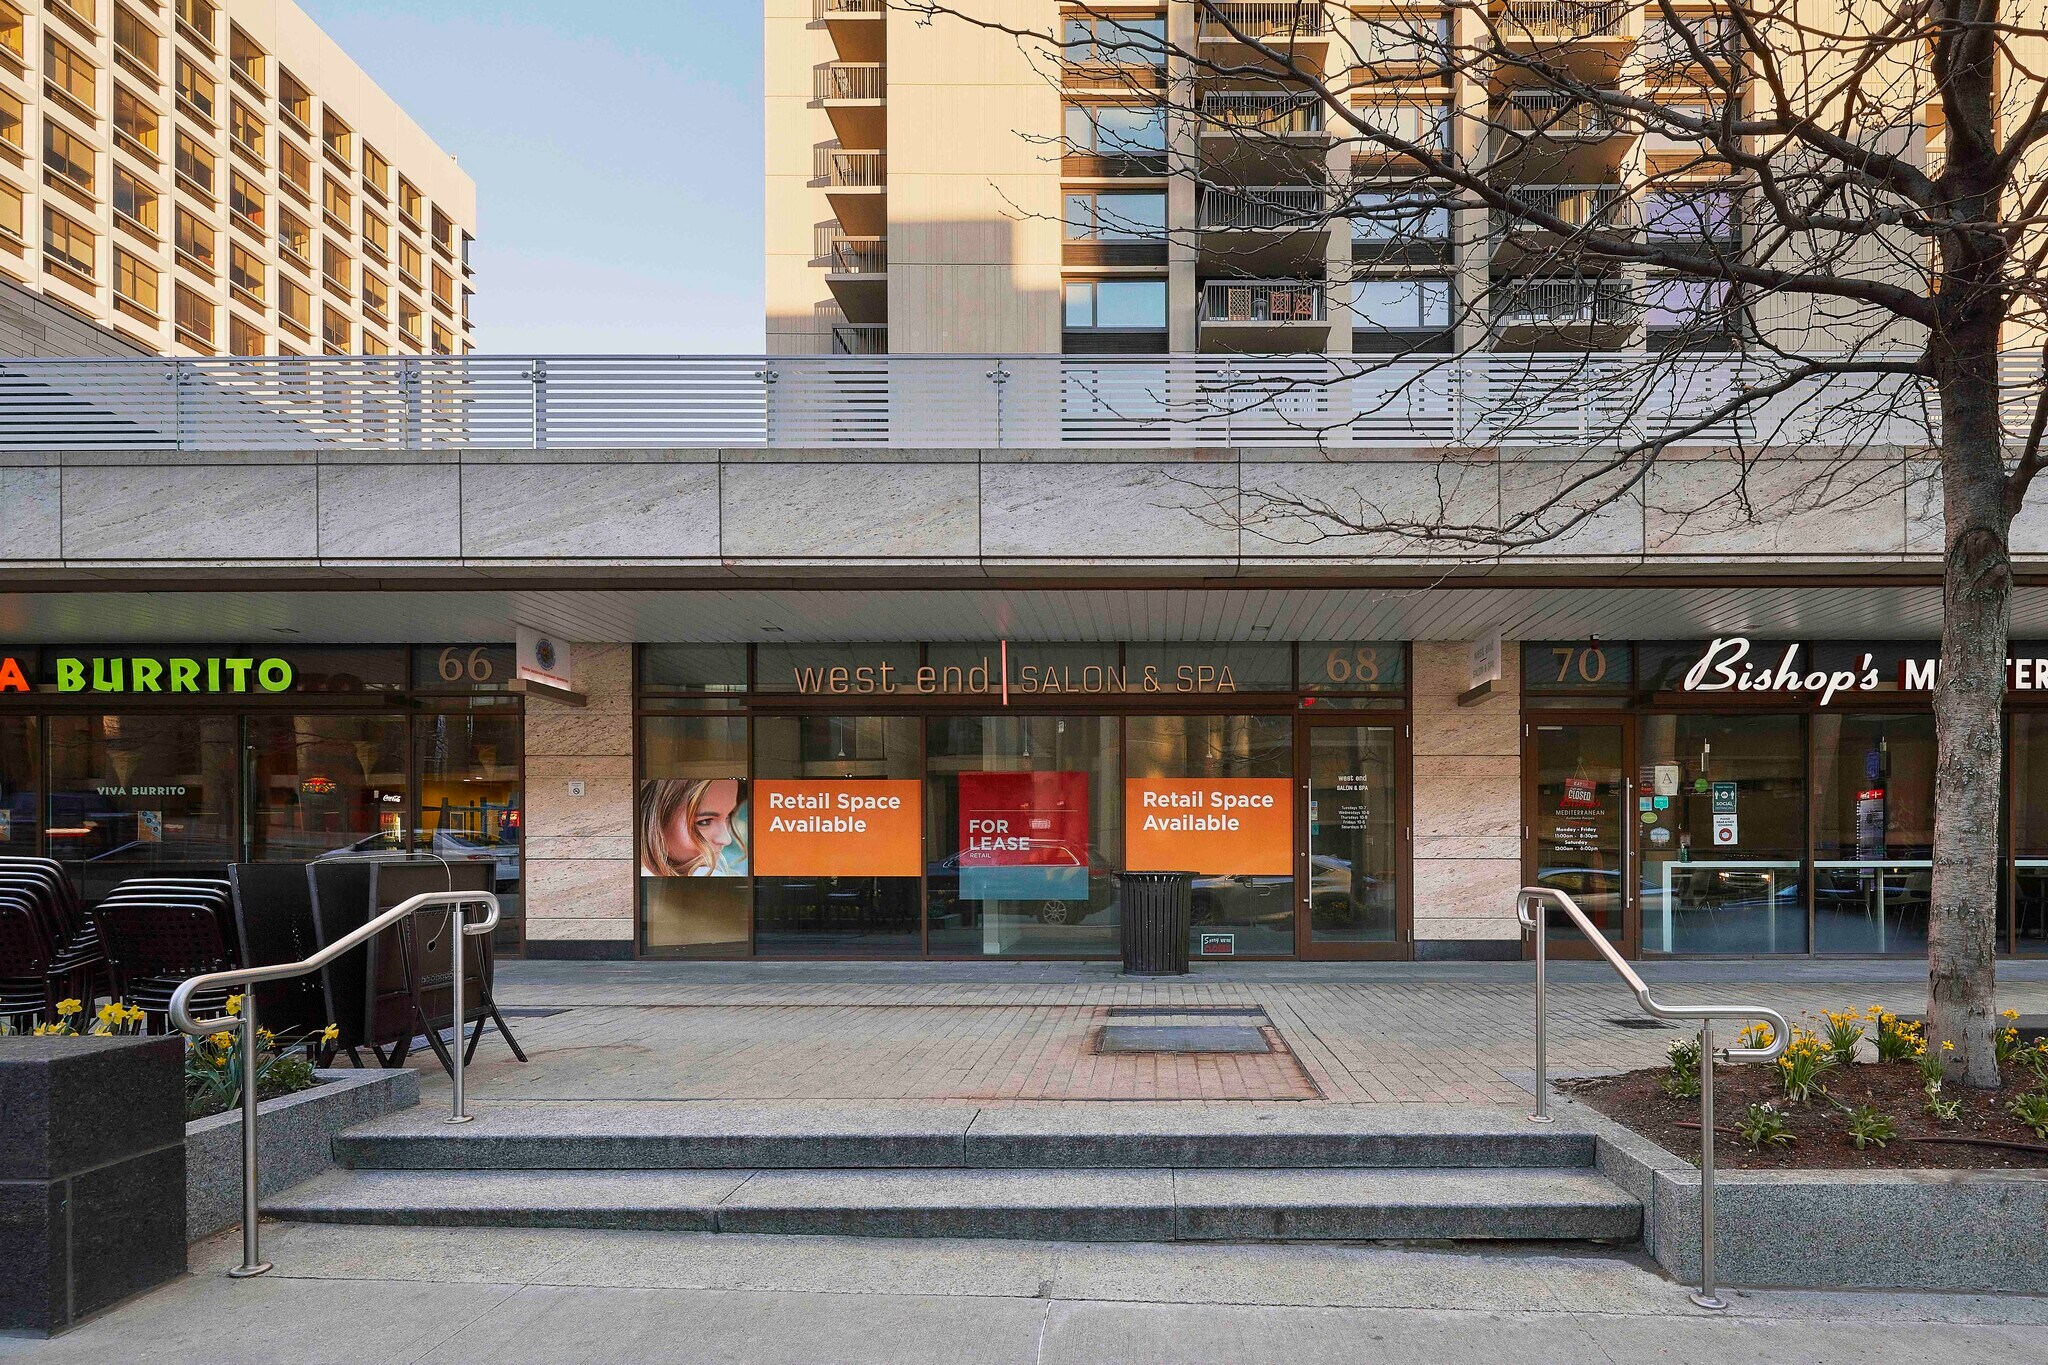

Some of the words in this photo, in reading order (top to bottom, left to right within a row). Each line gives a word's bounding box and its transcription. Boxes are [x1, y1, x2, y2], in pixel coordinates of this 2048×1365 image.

[438, 646, 493, 681] 66
[1326, 647, 1379, 682] 68
[1552, 647, 1606, 682] 70
[1684, 637, 1879, 707] Bishop's
[57, 657, 293, 692] BURRITO
[794, 661, 895, 693] west
[917, 656, 989, 693] end
[1021, 665, 1126, 693] SALON
[1143, 665, 1161, 693] &
[1176, 665, 1236, 693] SPA
[1662, 772, 1673, 784] A
[96, 786, 127, 796] VIVA
[131, 786, 186, 796] BURRITO
[1143, 791, 1203, 808] Retail
[1210, 791, 1274, 811] Space
[1568, 789, 1592, 801] CLOSED
[769, 792, 830, 809] Retail
[837, 792, 901, 813] Space
[769, 816, 867, 833] Available
[969, 819, 1009, 834] FOR
[1142, 814, 1240, 831] Available
[969, 836, 1030, 851] LEASE
